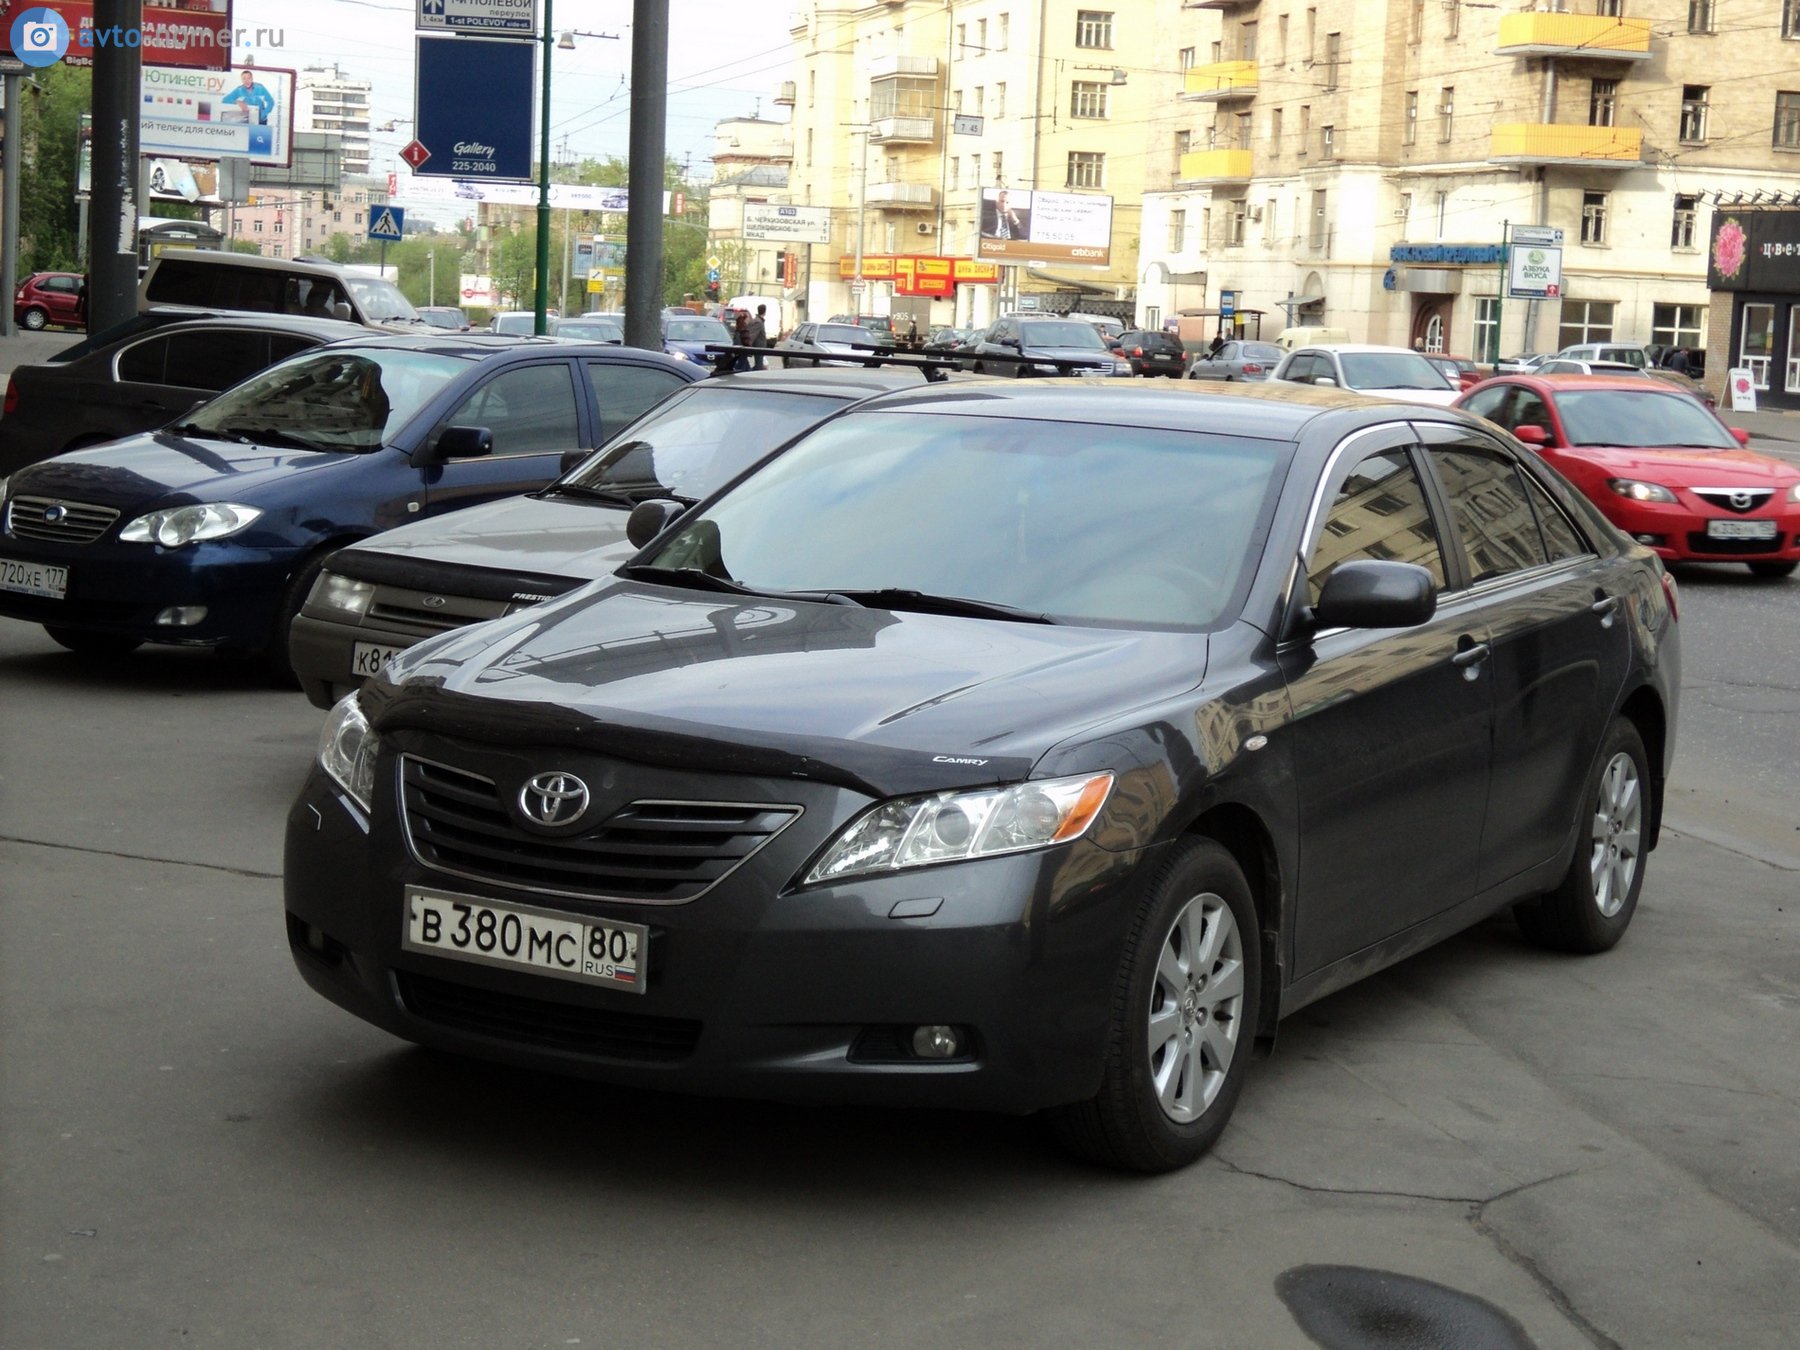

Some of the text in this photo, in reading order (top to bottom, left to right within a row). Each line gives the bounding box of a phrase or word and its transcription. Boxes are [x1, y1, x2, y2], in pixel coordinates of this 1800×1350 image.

[490, 9, 531, 18] переулок
[466, 17, 507, 27] POLEVOY
[66, 56, 94, 66] BigBo
[144, 69, 226, 92] Ютинет.ру
[156, 122, 184, 133] телек
[185, 125, 204, 136] для
[205, 127, 236, 138] семьи
[453, 141, 495, 158] Gallery
[452, 160, 497, 172] 225-2040
[754, 217, 807, 226] ЧЕРКИЗОВСКАЯ
[746, 231, 766, 239] МКАД
[1071, 248, 1104, 257] citibank
[1522, 265, 1551, 274] АЗБУКА
[1523, 272, 1549, 280] ВКУСА
[932, 755, 989, 767] CAMRY
[588, 926, 628, 964] 80
[585, 961, 614, 978] RUS
